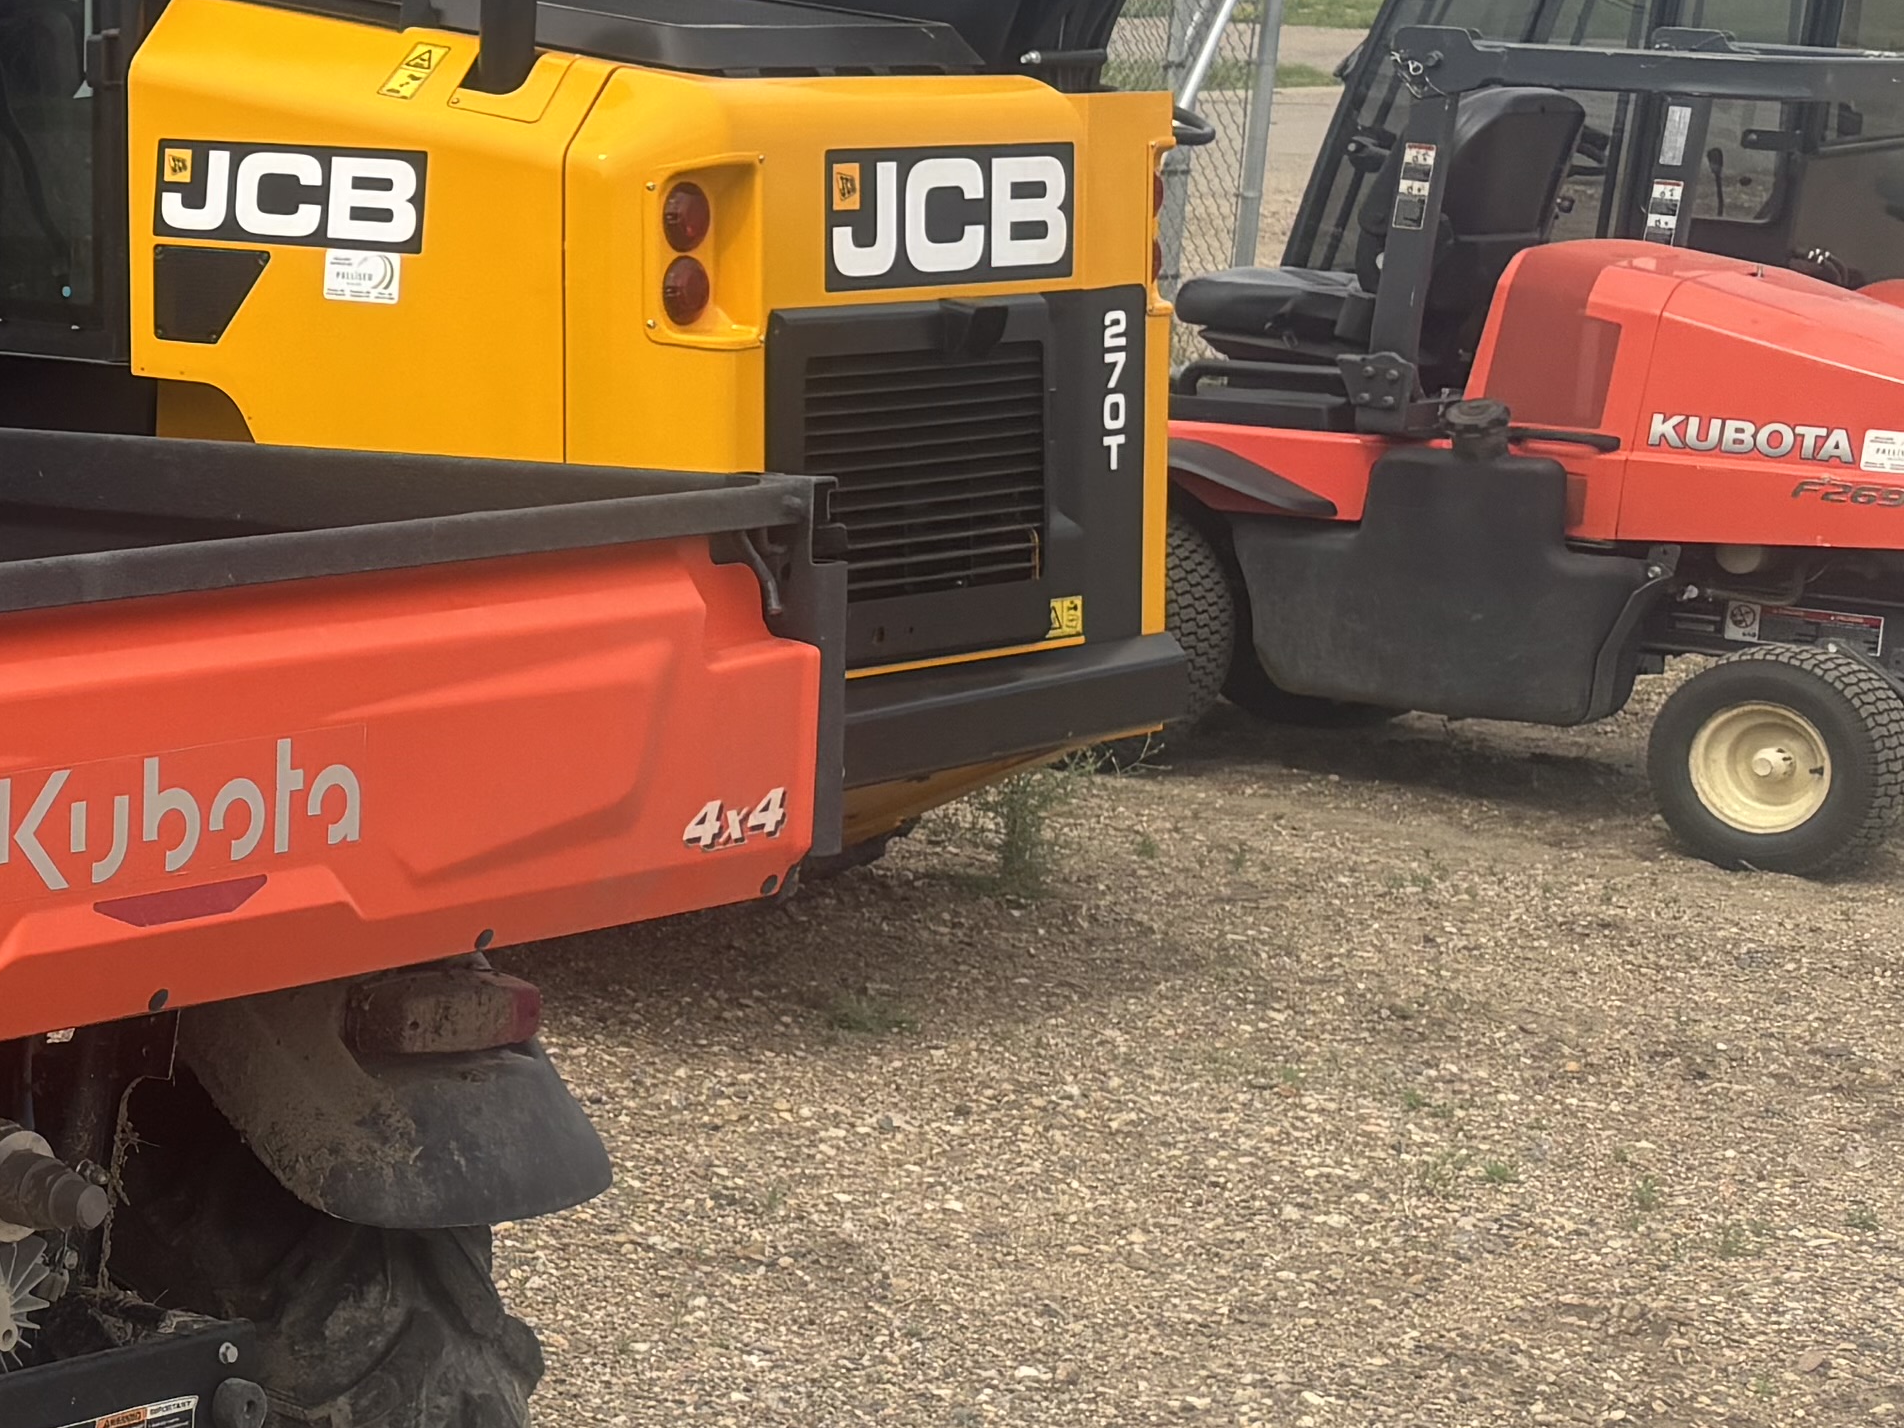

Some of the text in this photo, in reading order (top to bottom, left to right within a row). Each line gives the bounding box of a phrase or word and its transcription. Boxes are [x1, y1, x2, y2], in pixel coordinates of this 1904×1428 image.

[161, 150, 417, 242] JCB
[832, 155, 1067, 277] JCB
[1102, 310, 1127, 470] 270T
[1648, 413, 1855, 464] KUBOTA
[683, 787, 787, 851] 4x4
